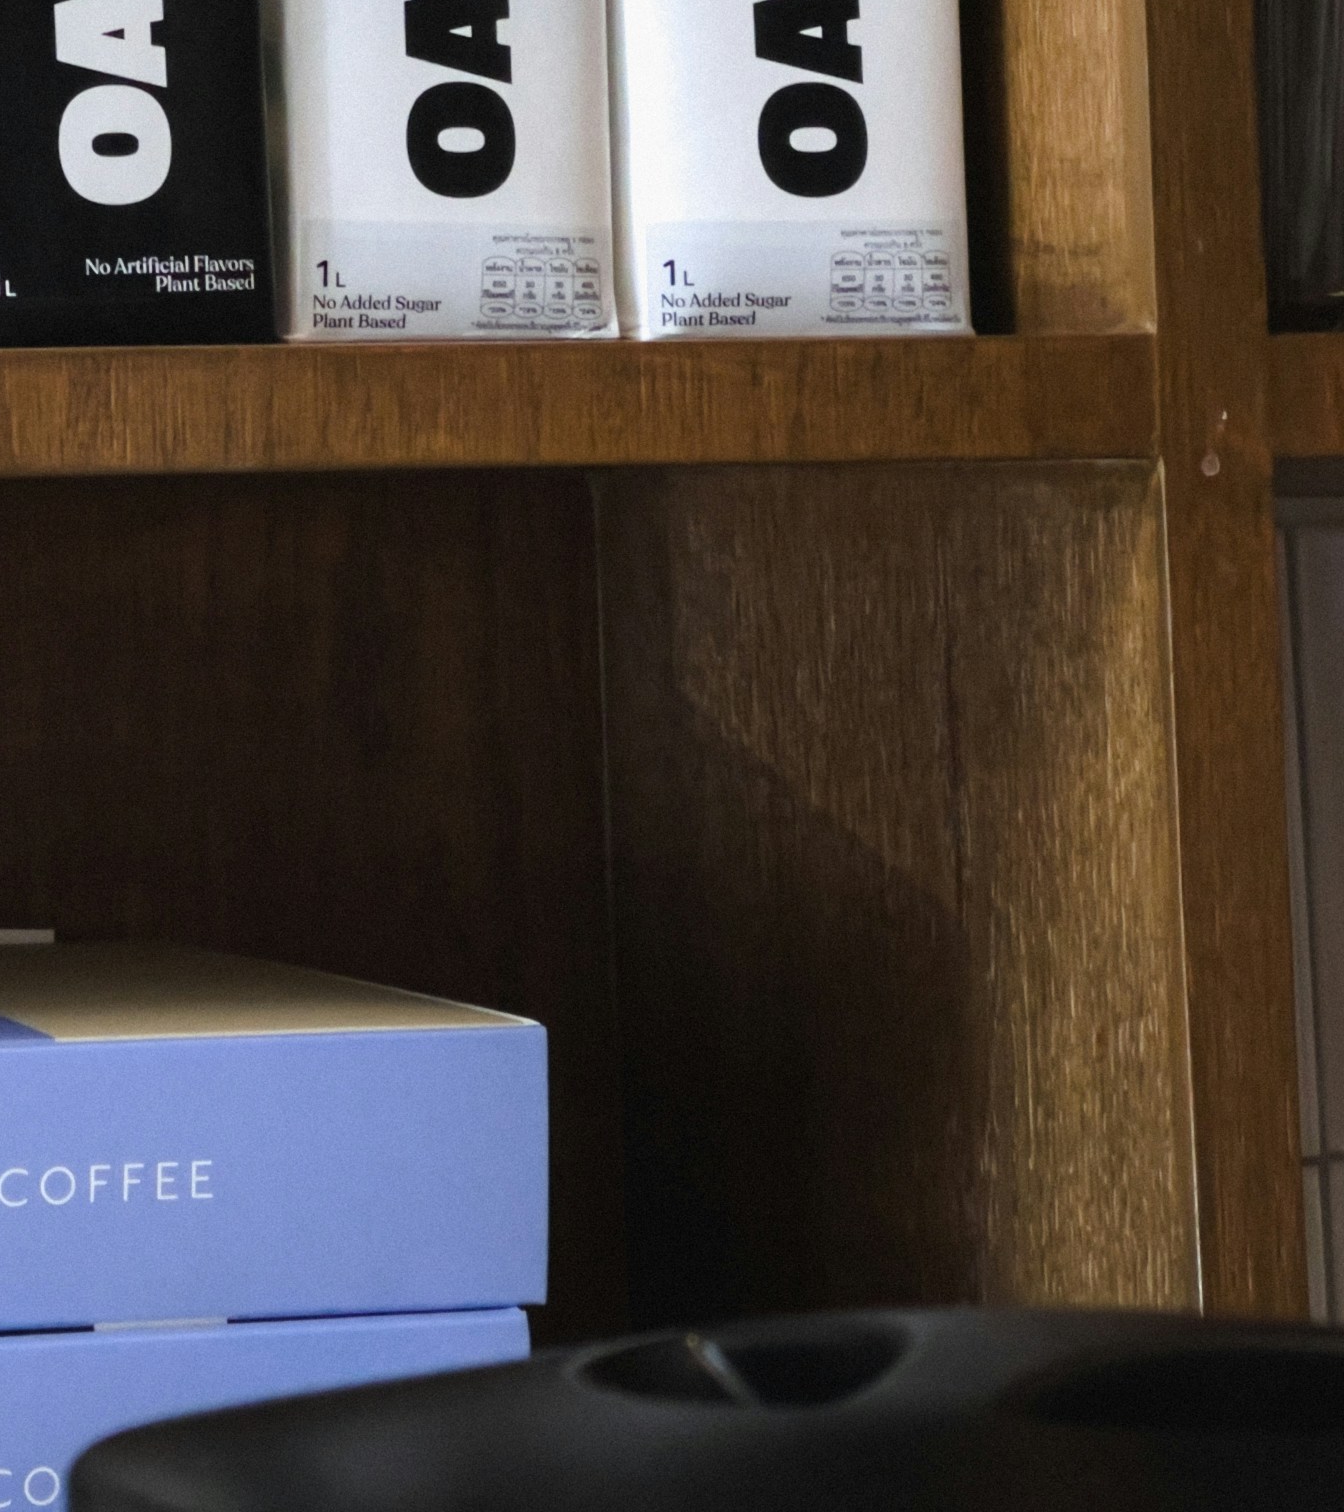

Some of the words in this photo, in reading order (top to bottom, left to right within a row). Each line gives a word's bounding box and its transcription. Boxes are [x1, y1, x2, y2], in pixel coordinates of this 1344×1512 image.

[85, 258, 112, 276] No
[114, 255, 190, 275] Artificial
[193, 255, 255, 273] Flavors
[155, 274, 201, 293] Plant
[204, 273, 255, 292] Based
[313, 294, 337, 310] No
[340, 294, 391, 311] Added
[395, 296, 442, 314] Sugar
[661, 293, 687, 308] No
[690, 292, 741, 308] Added
[744, 293, 791, 310] Sugar
[313, 313, 354, 329] Plant
[357, 313, 407, 329] Based
[662, 312, 706, 328] Plant
[708, 311, 756, 327] Based
